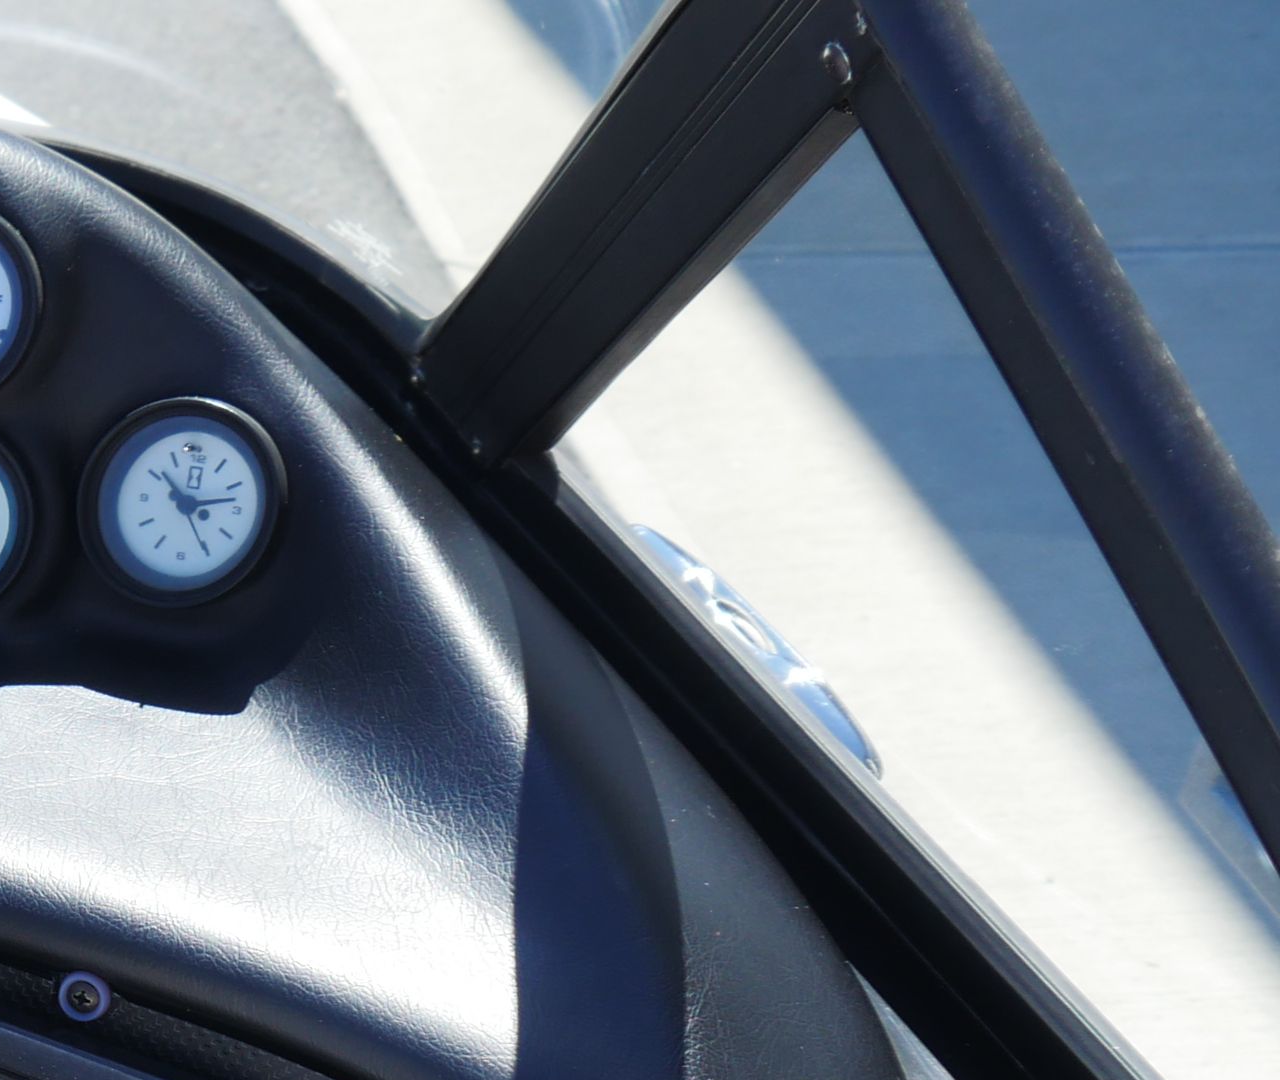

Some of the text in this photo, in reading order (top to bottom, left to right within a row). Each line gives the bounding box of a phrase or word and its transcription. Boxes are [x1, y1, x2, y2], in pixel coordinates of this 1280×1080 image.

[192, 454, 206, 464] 12
[140, 493, 148, 502] 9
[233, 506, 242, 515] 3
